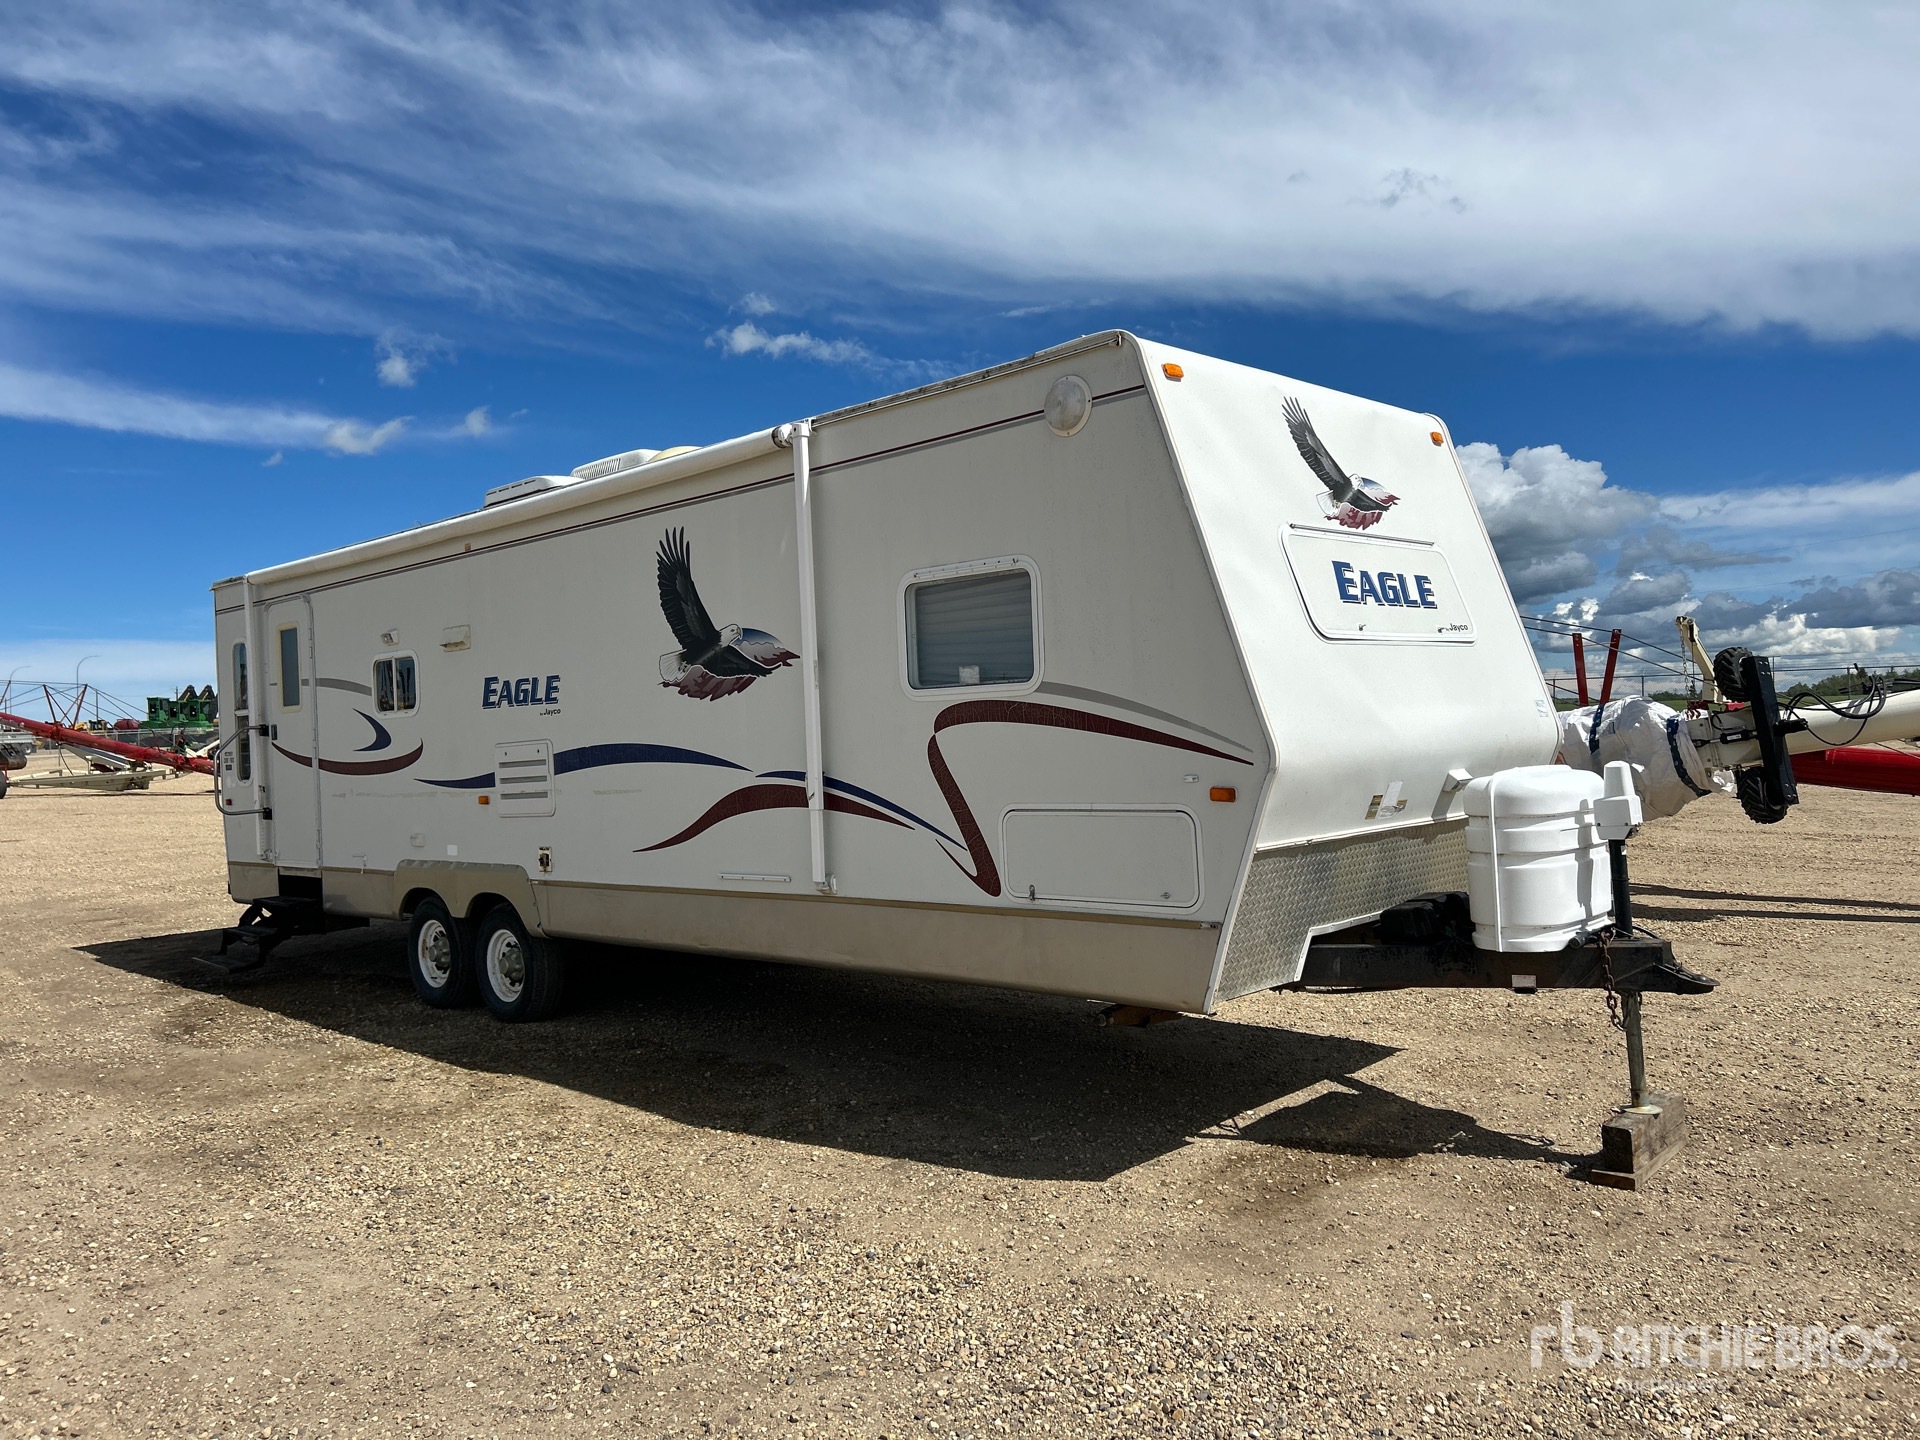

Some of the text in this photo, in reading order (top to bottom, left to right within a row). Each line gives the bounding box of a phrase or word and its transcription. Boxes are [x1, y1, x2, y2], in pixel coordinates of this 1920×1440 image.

[1331, 560, 1438, 609] EAGLE
[1449, 623, 1469, 632] Jayco
[482, 675, 561, 709] EAGLE
[544, 708, 561, 716] Jayco
